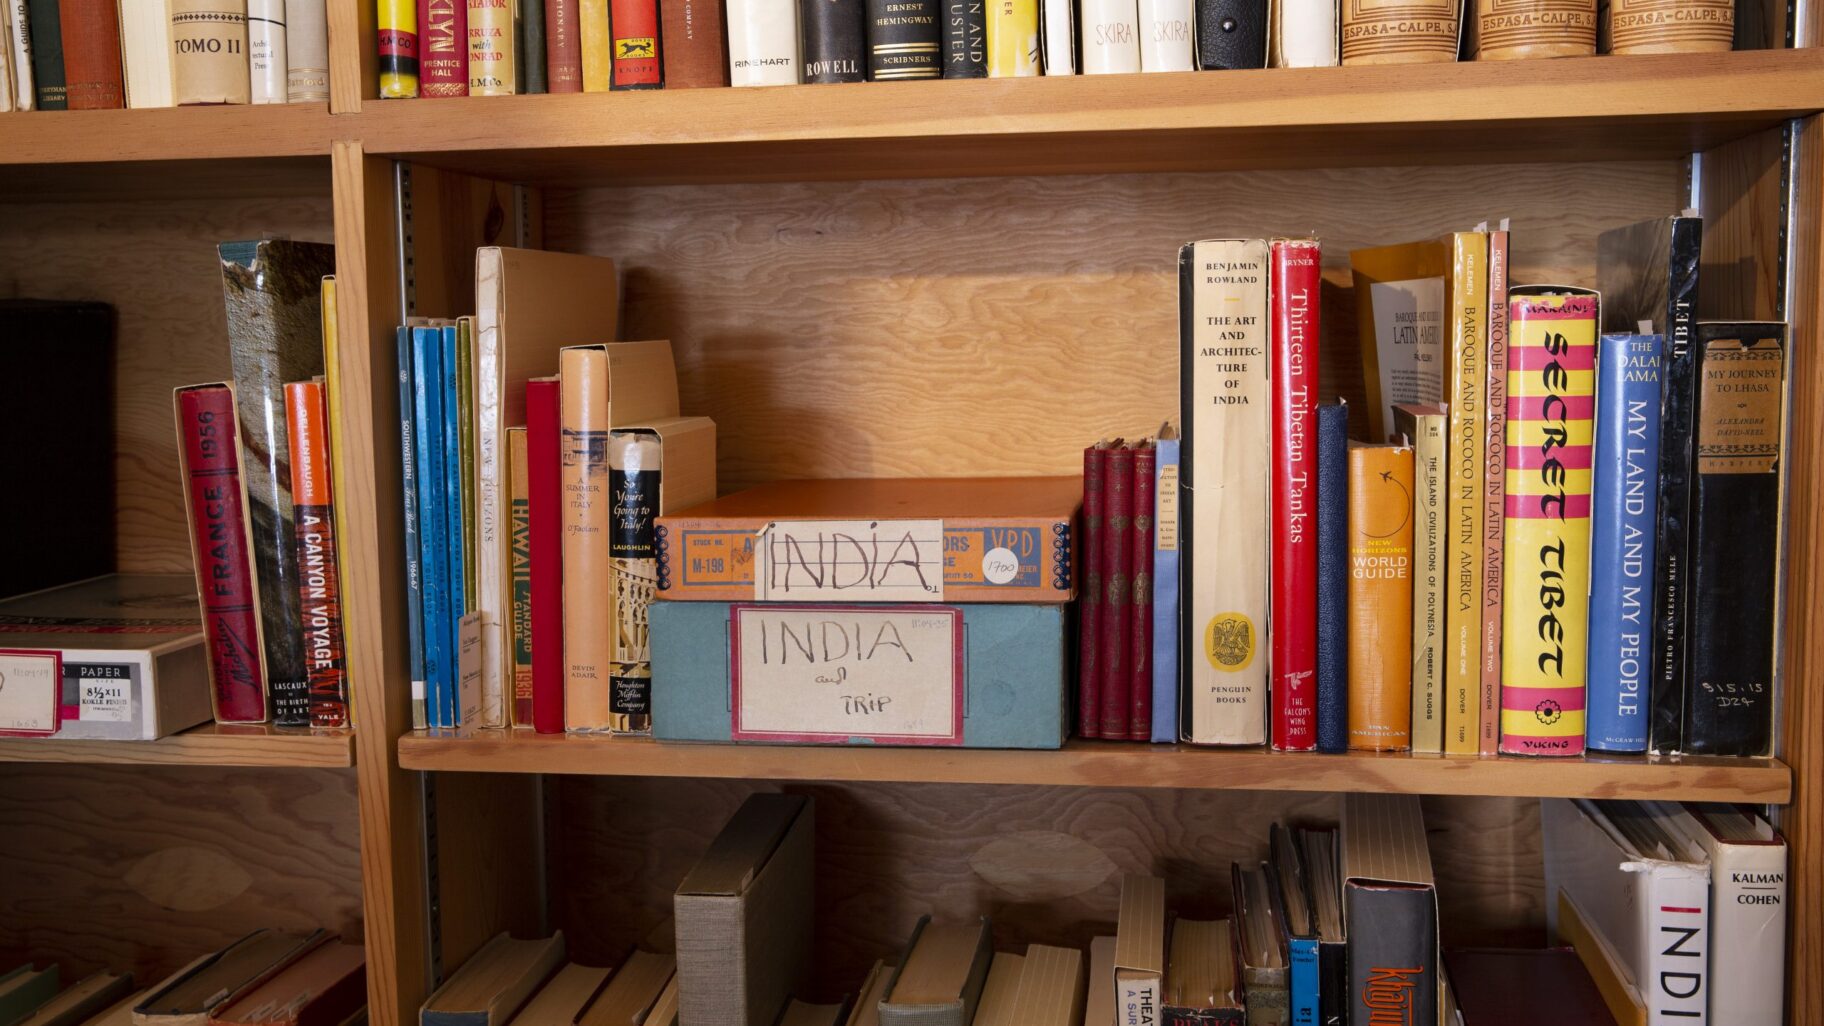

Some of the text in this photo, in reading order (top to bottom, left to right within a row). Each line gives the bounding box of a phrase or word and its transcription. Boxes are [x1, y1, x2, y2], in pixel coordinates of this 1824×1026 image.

[18, 6, 25, 16] TO
[886, 3, 924, 12] ERNEST
[876, 16, 934, 26] HEMINGWAY
[1482, 12, 1585, 30] ESPASA-CALPE,
[1614, 10, 1721, 28] ESPASA-CALPE,
[19, 20, 28, 44] GUIDE
[1096, 24, 1133, 46] SKIRA
[1153, 20, 1190, 42] SKIRA
[175, 38, 221, 54] TOMO
[228, 39, 240, 54] II
[472, 40, 491, 50] with
[969, 23, 983, 62] AND
[735, 58, 790, 68] RINEHART
[883, 55, 932, 64] SCRIBNERS
[1206, 262, 1258, 272] BENJAMIN
[1466, 254, 1474, 296] KELEMEN
[1207, 317, 1257, 326] THE ART
[1674, 299, 1690, 359] TIBET
[1219, 331, 1245, 340] AND
[1393, 326, 1418, 344] LATIN
[1462, 307, 1476, 375] BAROQUE
[1490, 303, 1504, 370] BAROQUE
[1200, 348, 1262, 357] ARCHITEC-
[1631, 343, 1653, 352] THE
[1216, 364, 1248, 372] TURE
[1618, 356, 1660, 368] DALAI
[1708, 369, 1777, 379] MY JOURNEY
[1224, 380, 1240, 389] OF
[1490, 376, 1502, 408] AND
[1716, 384, 1770, 392] TO LHASA
[1213, 396, 1249, 404] INDIA
[1463, 382, 1475, 412] AND
[1290, 288, 1308, 543] Thirteen Tibetan Tankas
[1627, 400, 1648, 440] MY
[198, 411, 218, 460] 1956
[1489, 414, 1501, 475] ROCOCO
[300, 408, 314, 497] DELLENBAUGH
[402, 420, 412, 480] SOUTHWESTERN
[1462, 418, 1475, 480] ROCOCO
[1429, 457, 1437, 472] THE
[624, 479, 636, 488] So
[1489, 481, 1500, 496] IN
[1625, 448, 1646, 516] LAND
[1429, 476, 1437, 507] ISLAND
[1462, 485, 1473, 500] IN
[613, 505, 650, 518] Going to
[1538, 331, 1568, 679] SECRET TIBET
[620, 518, 646, 533] Italy!
[1461, 506, 1473, 545] LATIN
[1488, 502, 1500, 540] LATIN
[204, 486, 233, 597] FRANCE
[513, 502, 530, 580] HAWAII
[1428, 511, 1437, 572] CIVILIZATIONS
[1623, 524, 1643, 578] AND
[693, 558, 724, 574] M-198
[1353, 556, 1408, 567] WORLD
[1353, 568, 1408, 579] GUIDE
[1428, 576, 1436, 588] OF
[1460, 550, 1473, 612] AMERICA
[1487, 547, 1499, 607] AMERICA
[304, 515, 333, 669] A CANYON VOYAGE
[1427, 592, 1436, 638] POLYNESIA
[1622, 586, 1641, 626] MY
[514, 600, 522, 640] GUIDE
[522, 590, 531, 653] STANDARD
[762, 618, 913, 664] INDIA
[1665, 644, 1674, 680] PIETRO
[81, 667, 120, 676] PAPER
[814, 666, 846, 685] and
[1618, 633, 1640, 716] PEOPLE
[274, 682, 307, 690] LASCAUX
[616, 680, 645, 690] Houghton
[617, 690, 641, 700] Mifflin
[616, 700, 645, 711] Company
[1284, 708, 1311, 716] FALCON'S
[1290, 728, 1307, 736] PRESS
[1522, 740, 1569, 748] VIKING
[1732, 873, 1784, 883] KALMAN
[1737, 894, 1780, 904] COHEN
